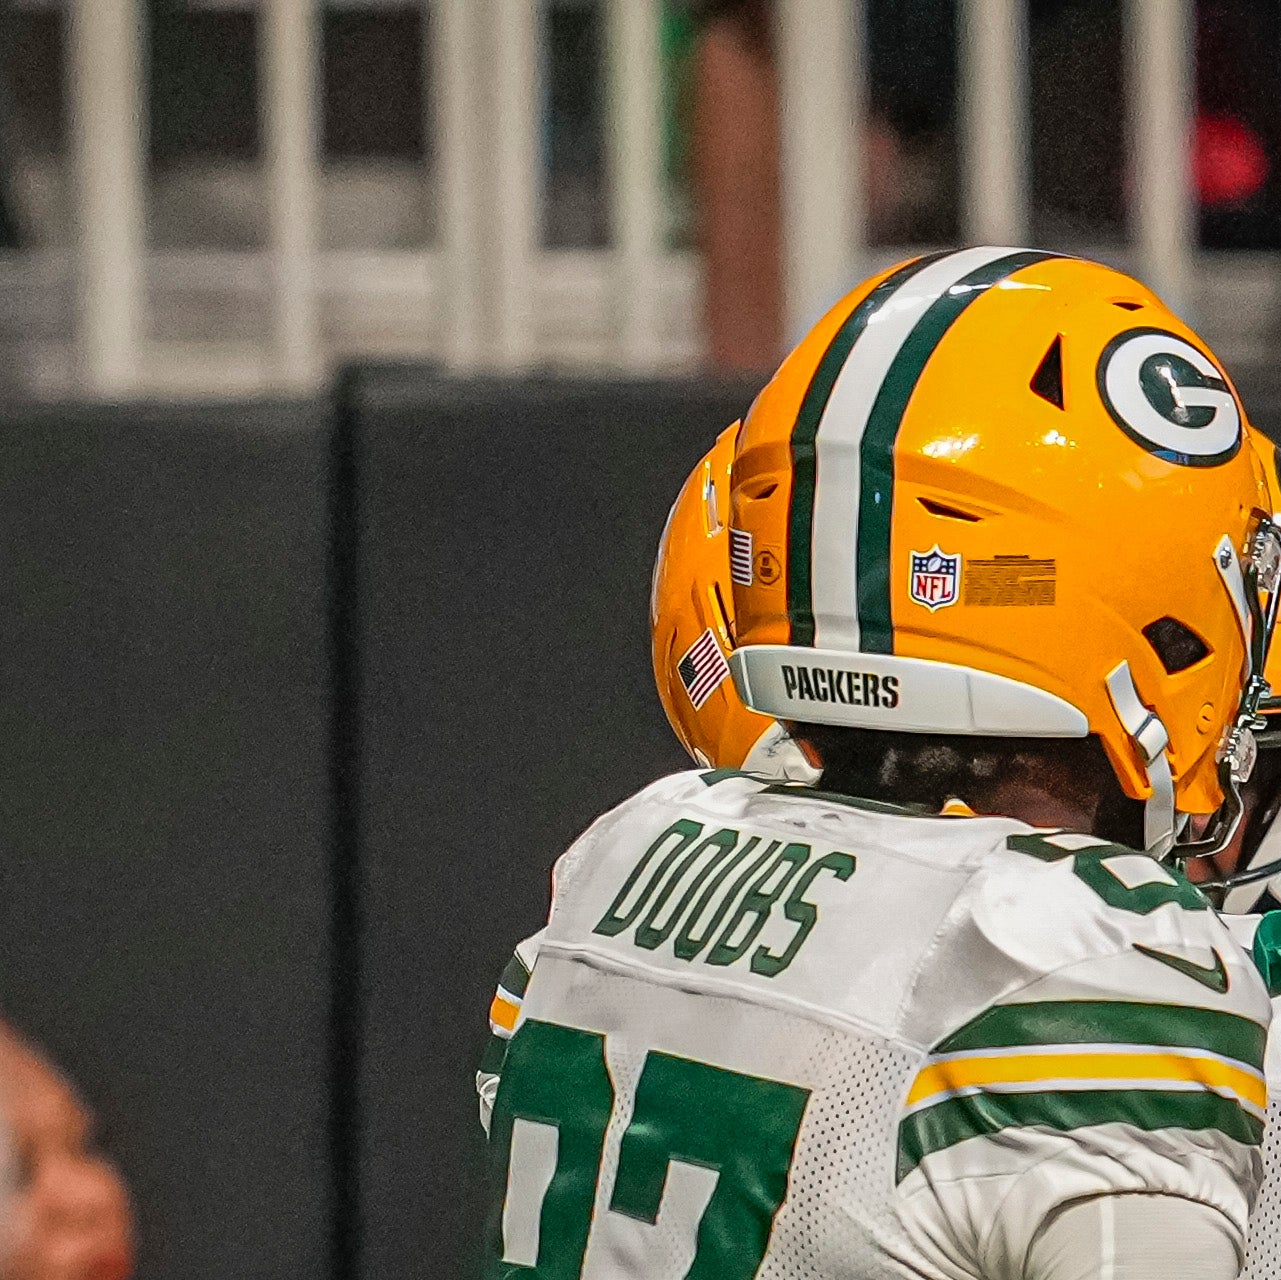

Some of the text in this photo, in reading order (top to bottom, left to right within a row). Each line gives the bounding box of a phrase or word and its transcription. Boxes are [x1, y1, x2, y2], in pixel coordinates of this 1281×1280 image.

[1104, 331, 1242, 461] G
[914, 574, 952, 601] NFL
[781, 664, 899, 709] PACKERS
[593, 818, 856, 978] DOUBS
